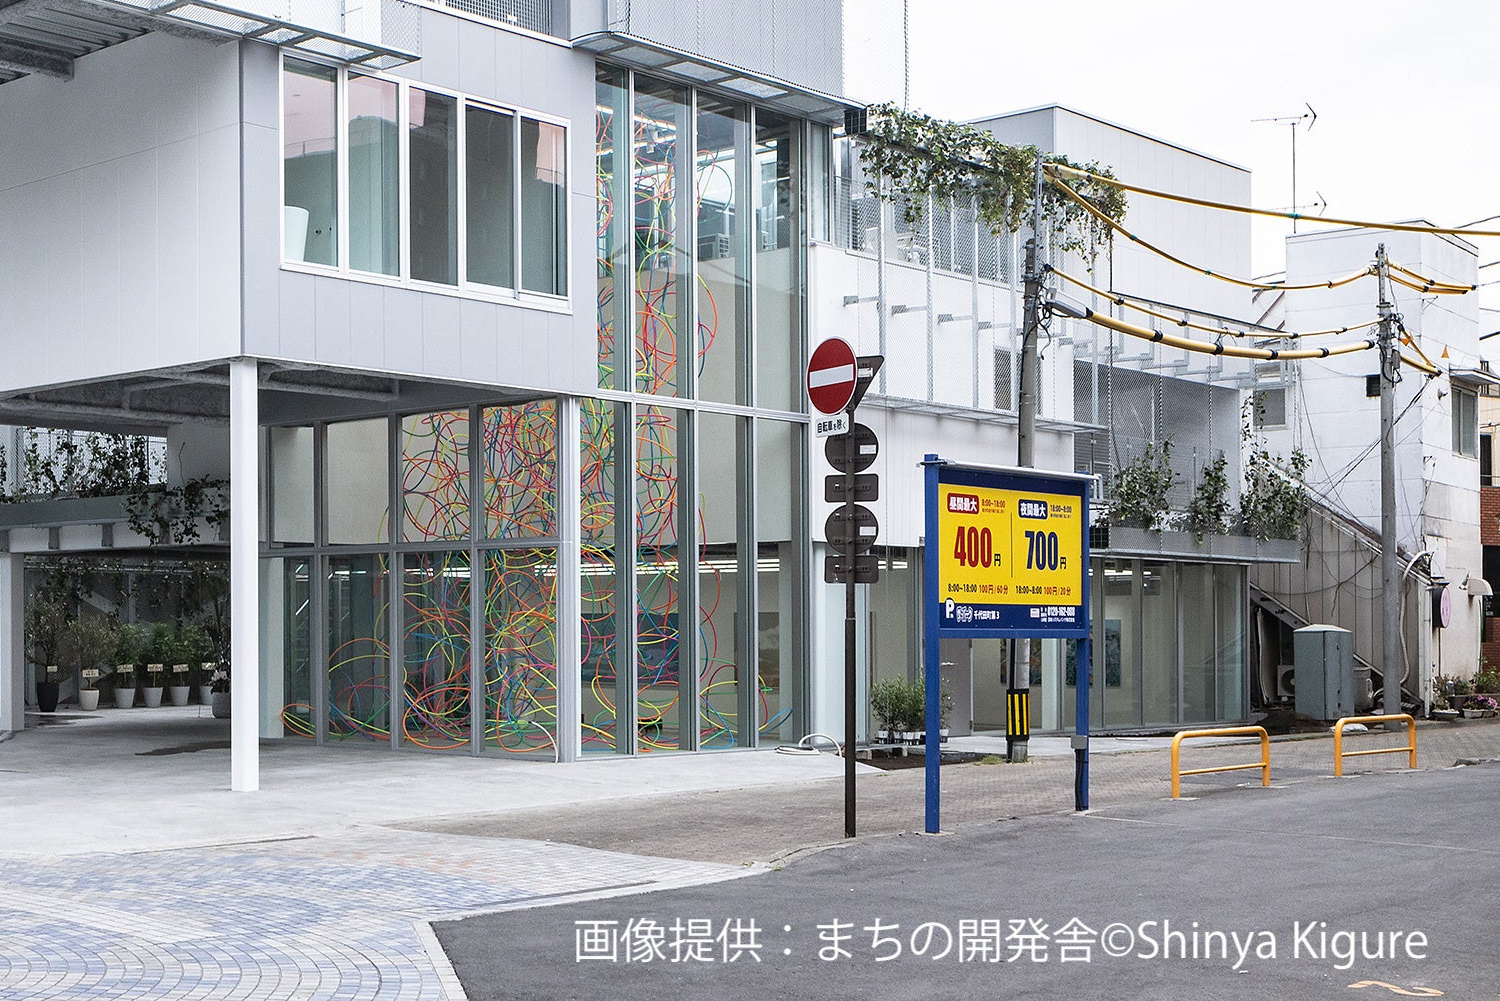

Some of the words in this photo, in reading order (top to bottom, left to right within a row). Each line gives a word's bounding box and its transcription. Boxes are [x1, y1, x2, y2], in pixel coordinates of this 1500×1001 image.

[817, 418, 846, 434] 自転車を除く
[950, 496, 977, 512] 昼間最大
